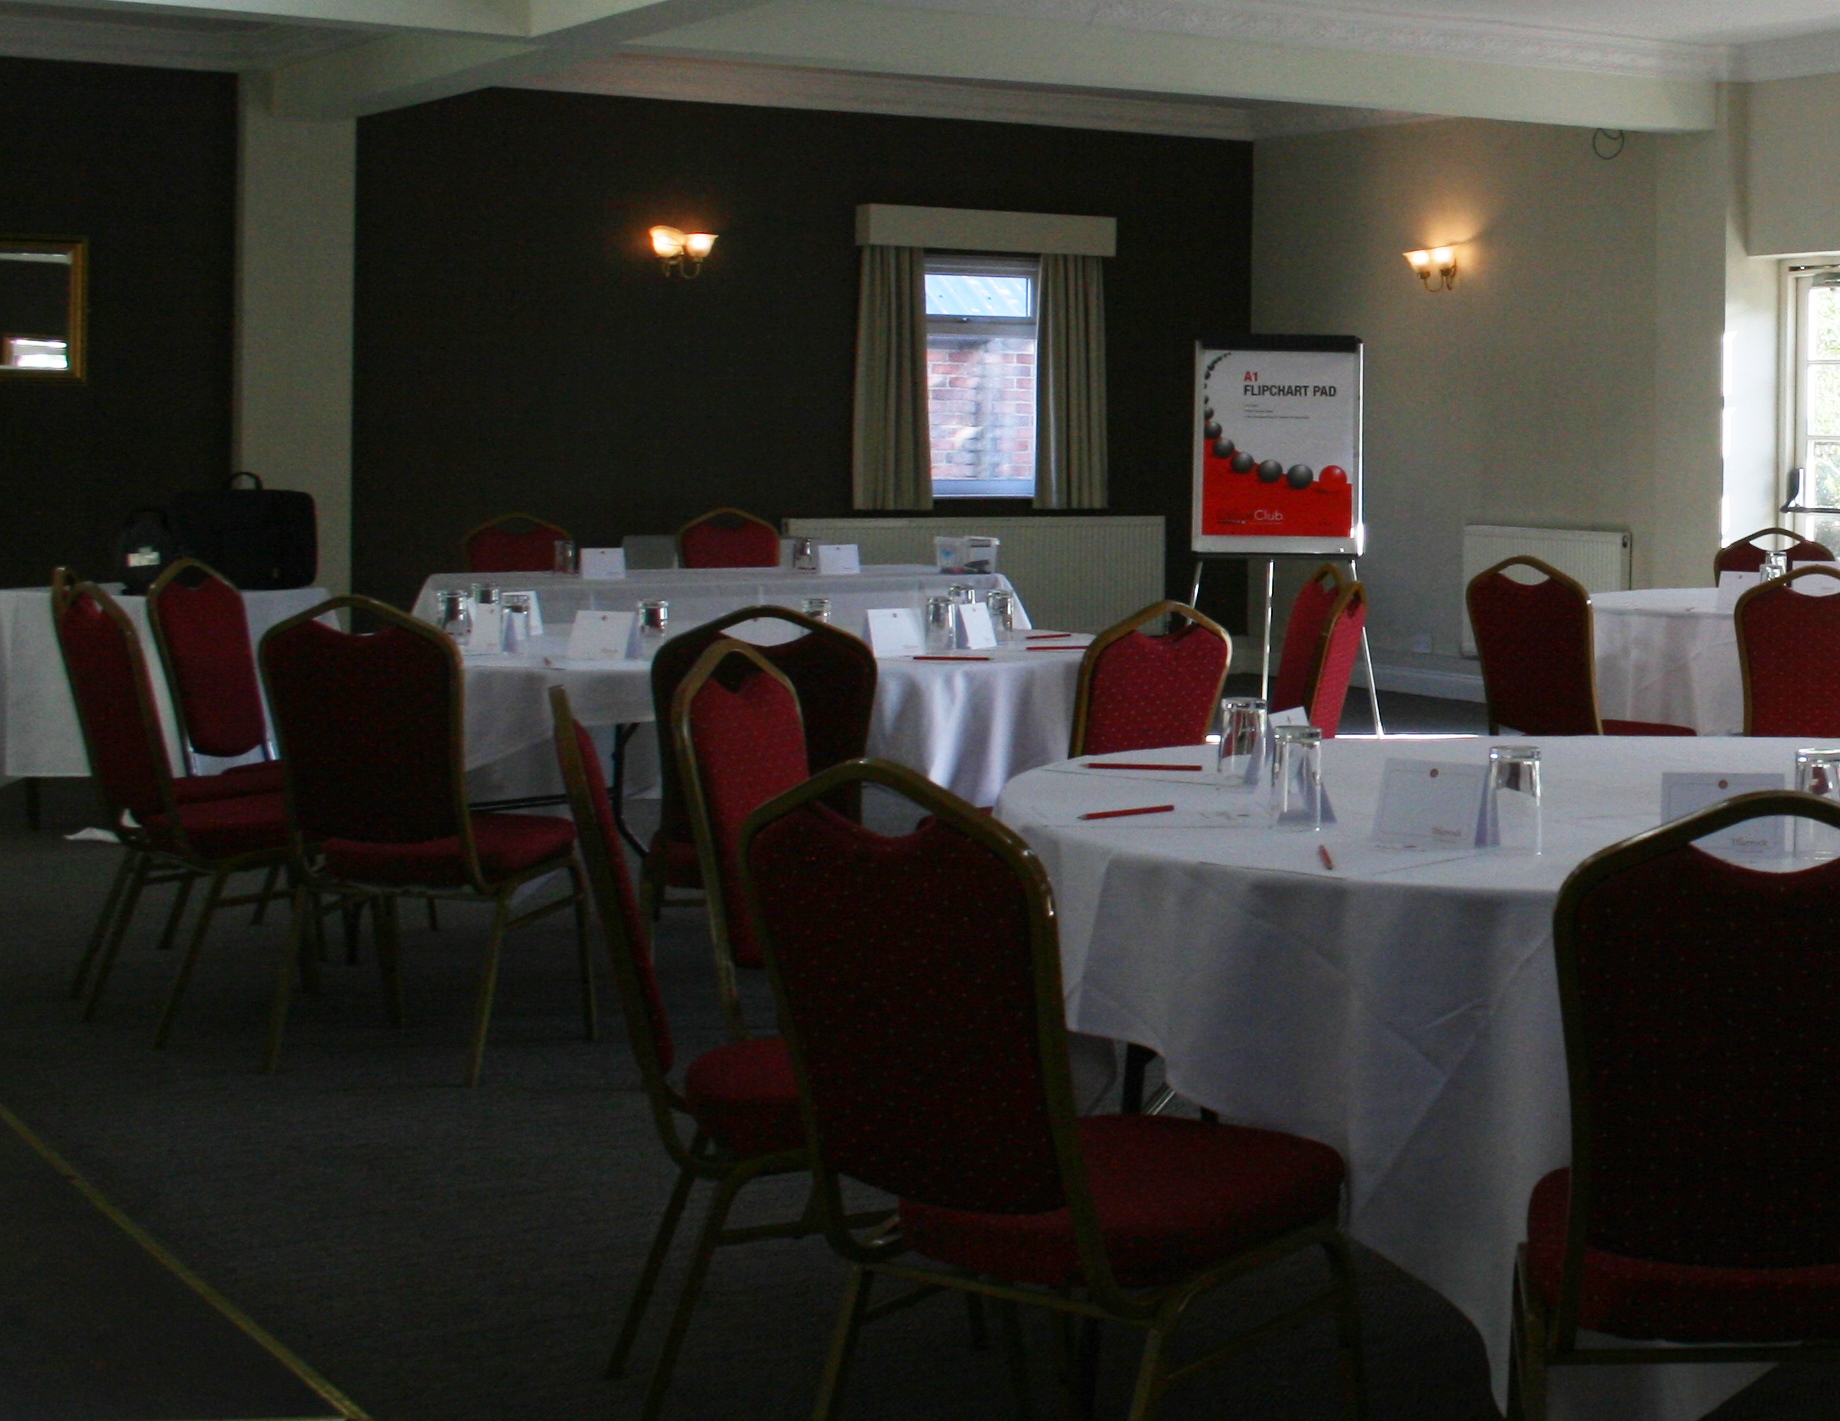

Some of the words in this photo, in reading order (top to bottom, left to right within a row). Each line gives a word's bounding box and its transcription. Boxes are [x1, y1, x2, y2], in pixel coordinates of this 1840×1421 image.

[1243, 371, 1258, 382] A1
[1243, 384, 1309, 397] FLIPCHART
[1312, 386, 1337, 397] PAD
